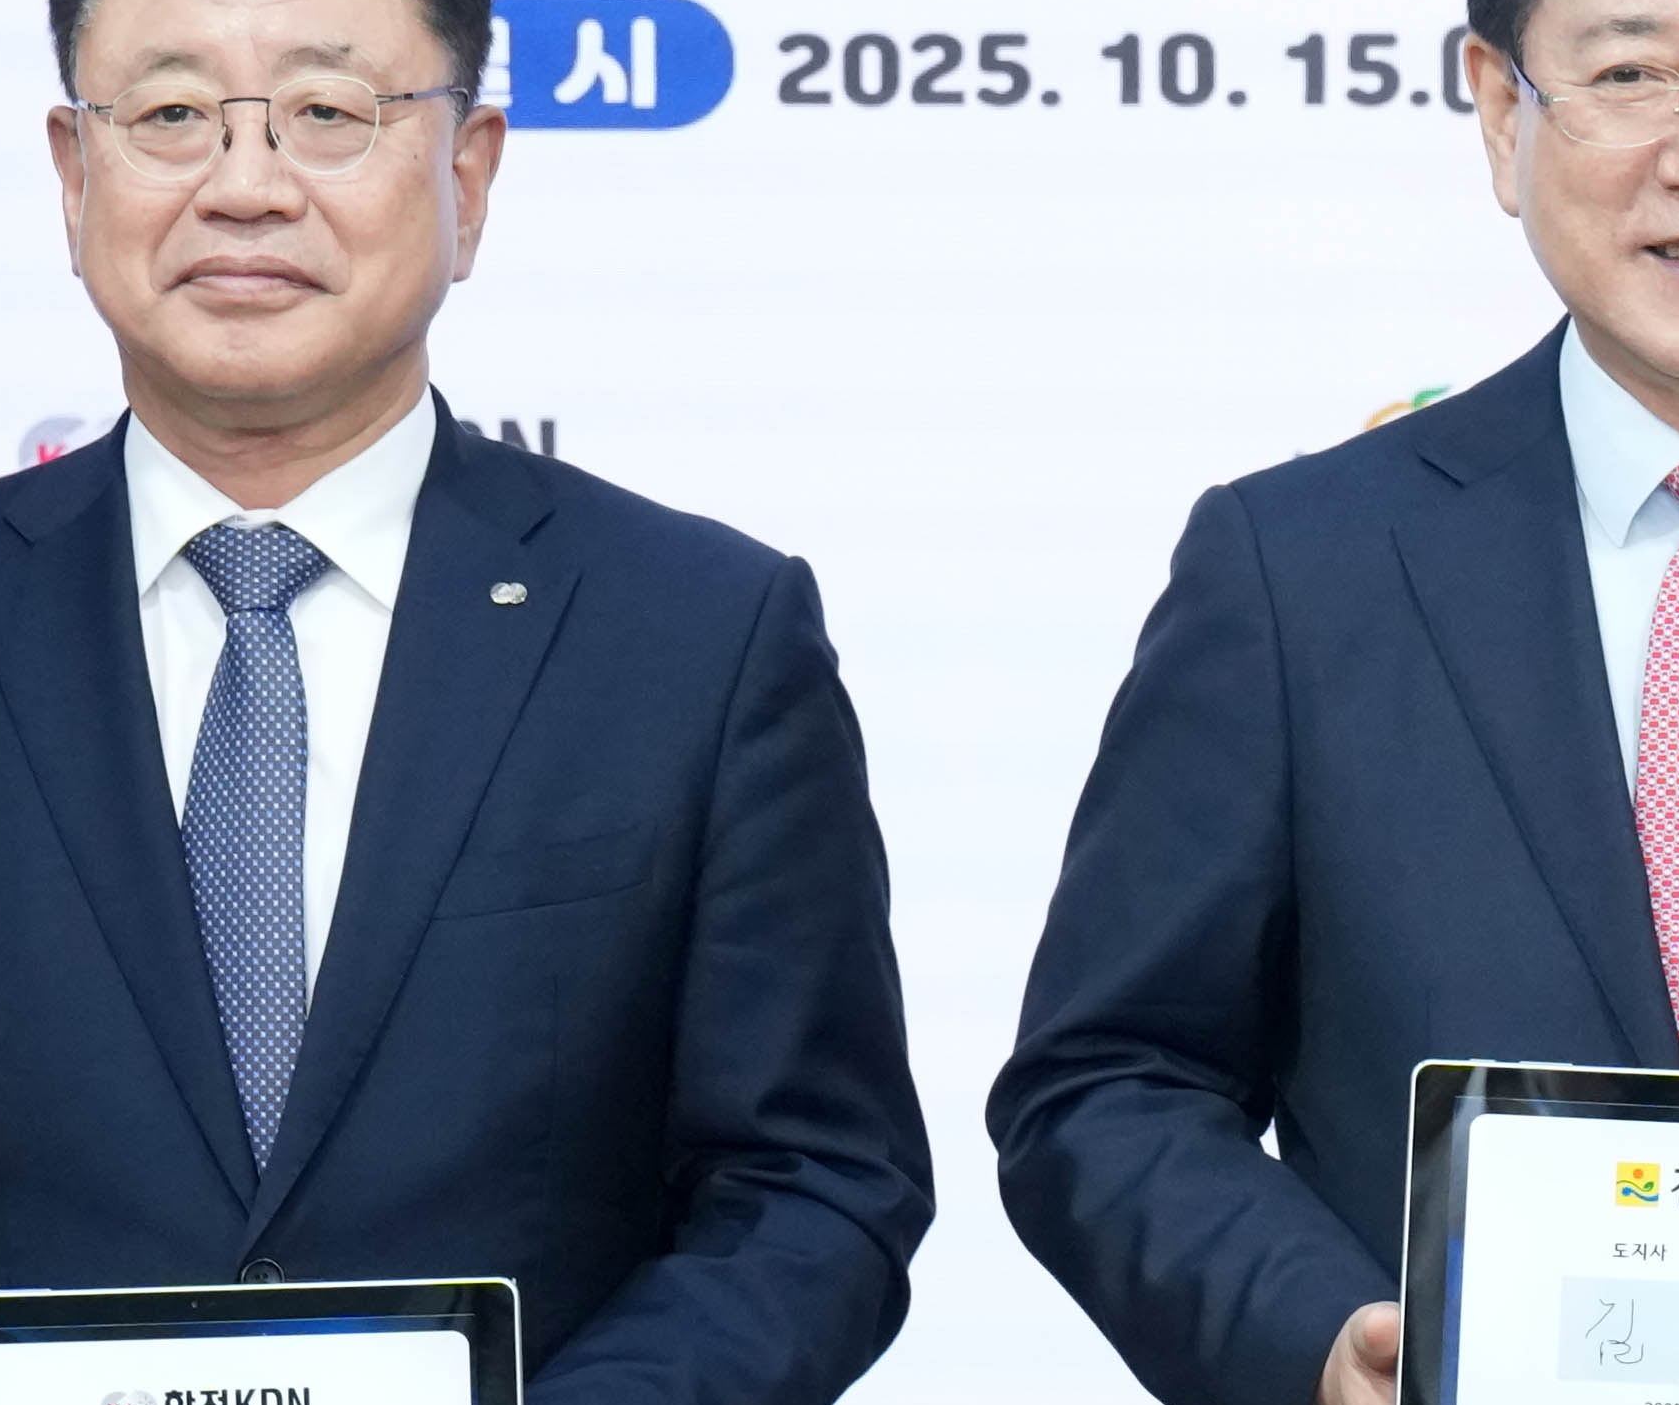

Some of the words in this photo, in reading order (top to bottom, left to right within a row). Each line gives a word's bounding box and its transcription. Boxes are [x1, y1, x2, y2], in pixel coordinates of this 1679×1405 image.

[777, 32, 1061, 108] 2025.
[1101, 32, 1248, 108] 10.
[1612, 1242, 1667, 1262] 도지사
